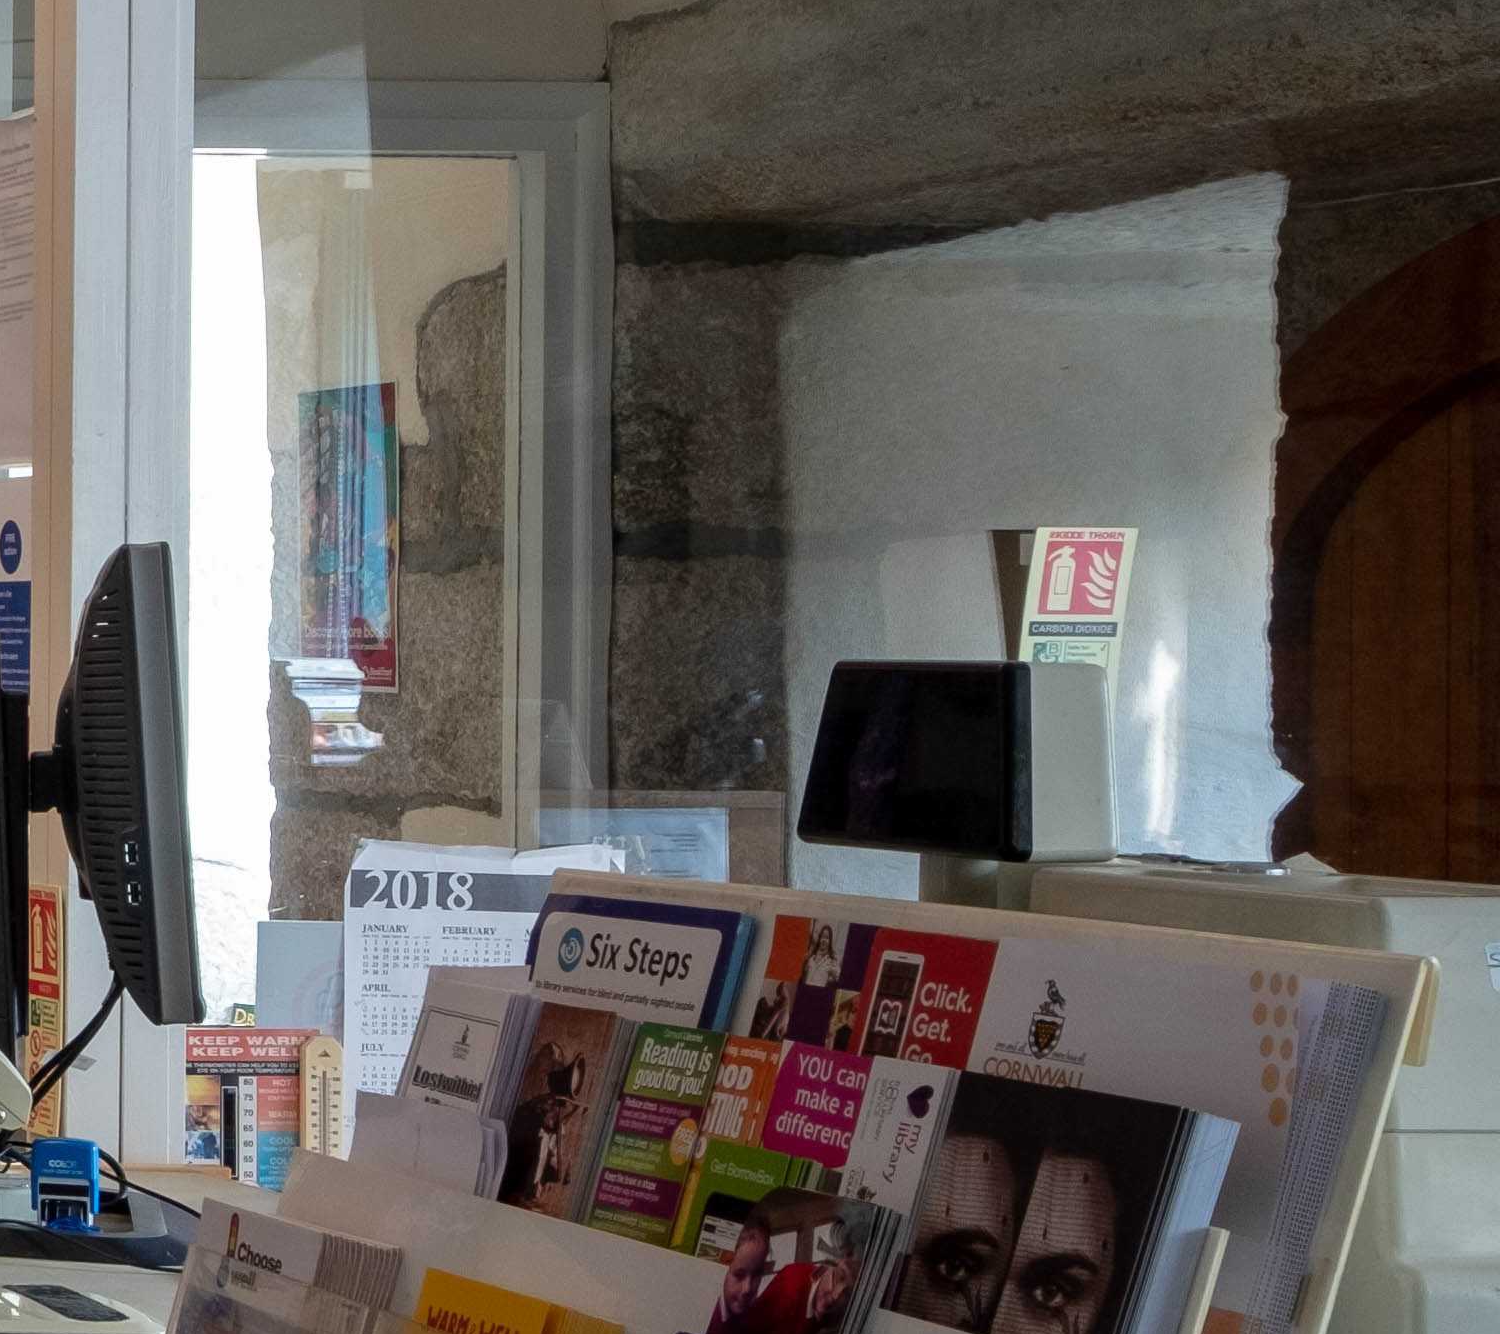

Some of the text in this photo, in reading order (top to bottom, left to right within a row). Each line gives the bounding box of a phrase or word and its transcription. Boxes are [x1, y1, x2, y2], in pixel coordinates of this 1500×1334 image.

[1031, 624, 1114, 634] CARBON DIOXIDE
[362, 870, 475, 912] 2018
[360, 923, 498, 937] JANUARY FEBRUARY
[585, 932, 693, 988] Six Steps
[360, 983, 392, 994] APRIL
[919, 981, 973, 1014] Click.
[188, 1035, 240, 1046] KEEP
[911, 1013, 953, 1043] Get.
[191, 1046, 245, 1058] KEEP
[360, 1042, 386, 1053] JULY
[640, 1036, 714, 1076] Reading is
[632, 1067, 707, 1098] good for you!
[797, 1052, 867, 1088] YOU can
[793, 1087, 855, 1119] make a
[882, 1121, 909, 1185] library
[904, 1123, 922, 1155] my
[236, 1241, 283, 1275] Choose
